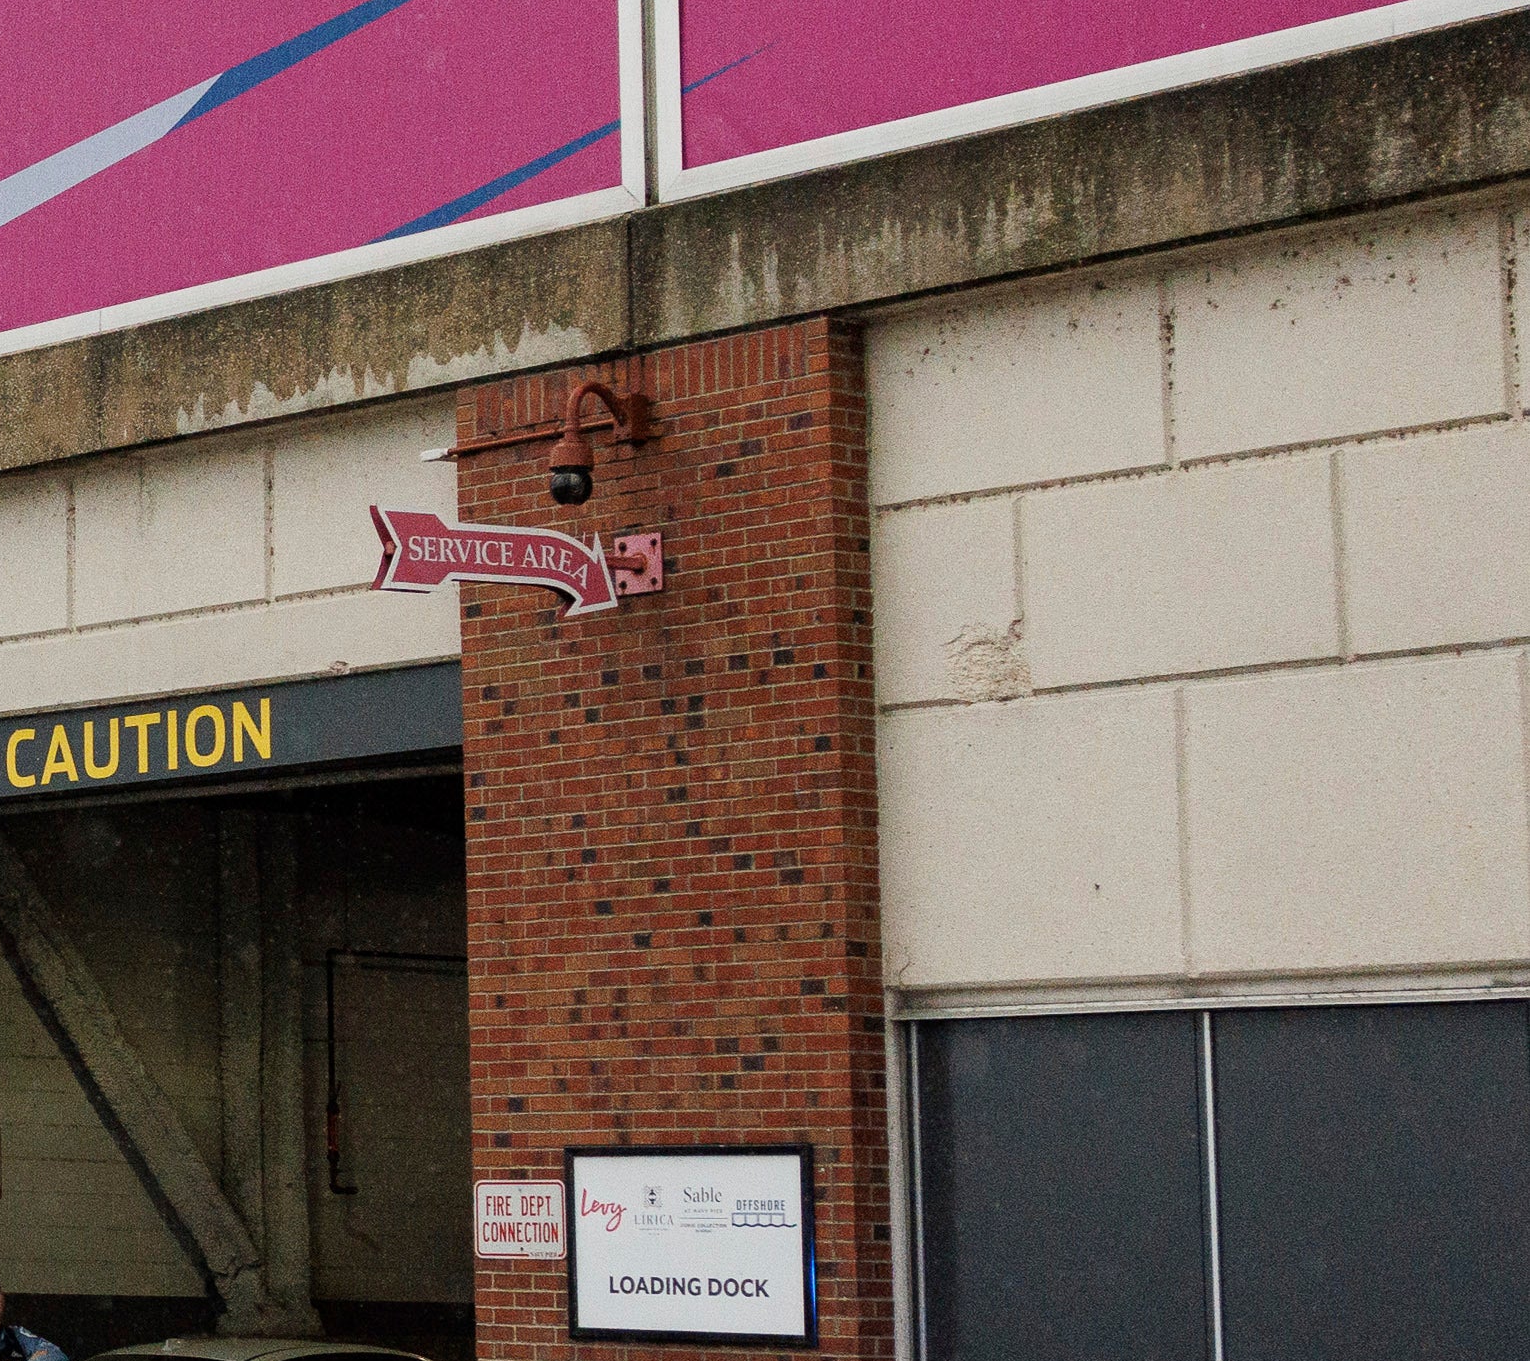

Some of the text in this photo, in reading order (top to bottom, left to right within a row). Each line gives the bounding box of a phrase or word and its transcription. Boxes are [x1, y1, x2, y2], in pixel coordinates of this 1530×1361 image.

[408, 535, 588, 589] SERVICE AREA
[5, 697, 272, 789] CAUTION
[683, 1186, 722, 1203] Sable
[736, 1199, 786, 1211] OFFSHORE
[485, 1195, 554, 1217] FIRE DEPT.
[581, 1188, 627, 1232] Levy
[634, 1214, 675, 1226] LIRICA
[482, 1222, 559, 1243] CONNECTION
[609, 1275, 770, 1298] LOADING DOCK
